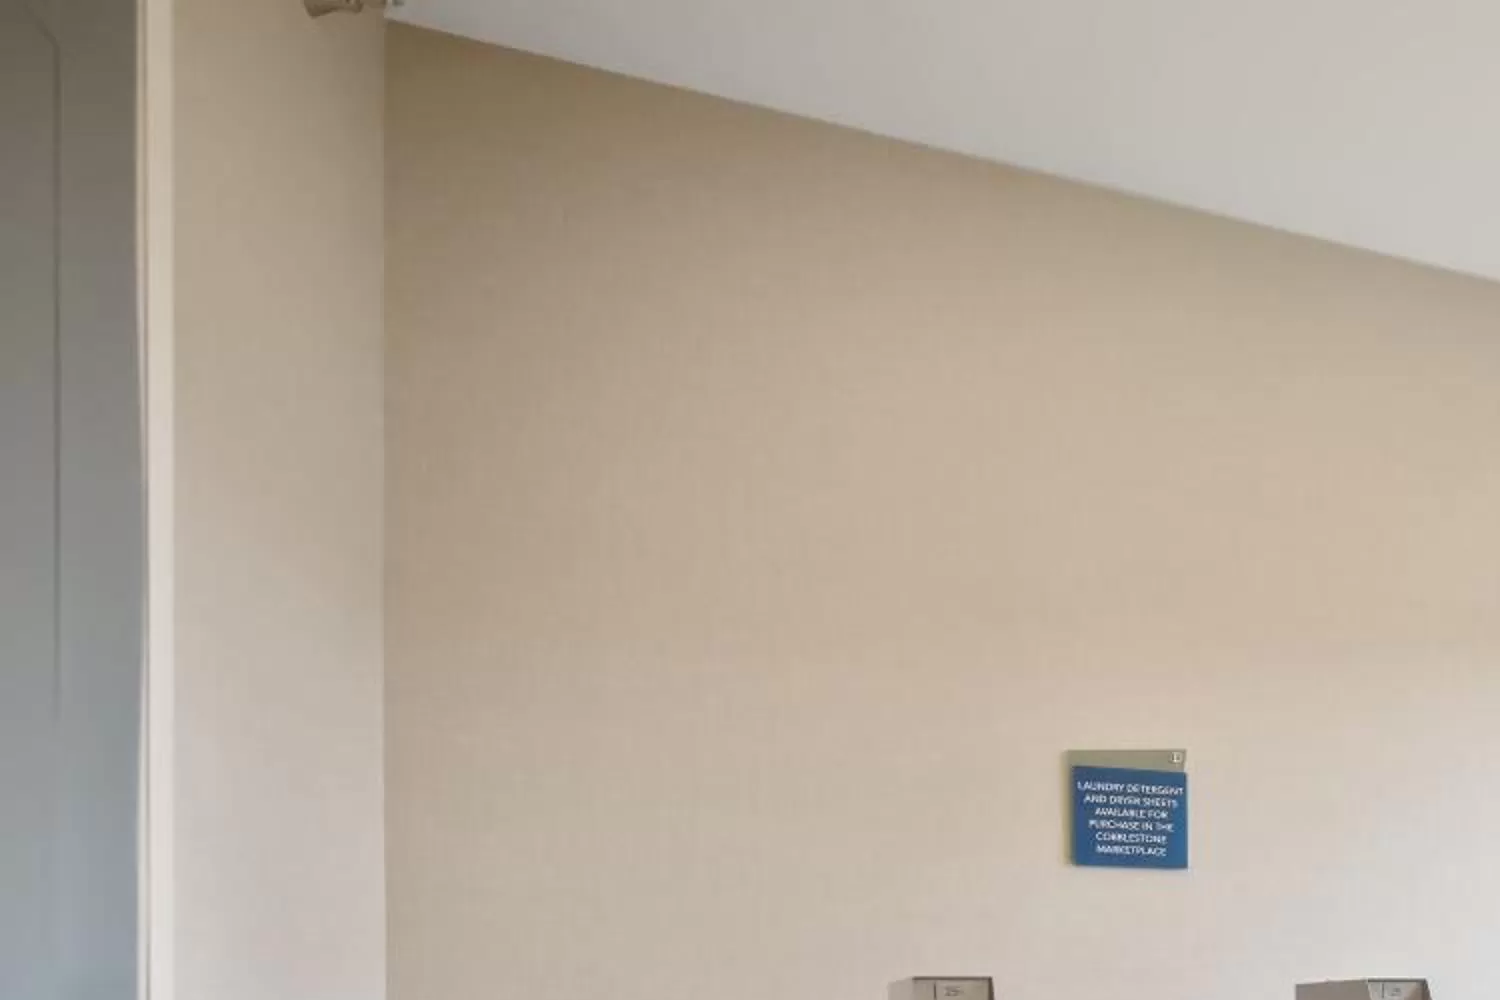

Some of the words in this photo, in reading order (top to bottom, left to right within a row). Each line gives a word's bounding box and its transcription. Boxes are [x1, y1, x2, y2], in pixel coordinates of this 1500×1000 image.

[1077, 781, 1124, 792] LAUNDRY
[1126, 784, 1184, 795] DETERGENT
[1084, 795, 1107, 804] AND
[1109, 796, 1140, 806] DRYER
[1143, 798, 1178, 808] SHEETS
[1095, 807, 1146, 818] AVAILABLE
[1147, 809, 1168, 819] FOR
[1089, 820, 1140, 831] PURCHASE
[1141, 822, 1153, 831] IN
[1155, 823, 1175, 832] THE
[1095, 831, 1167, 844] COBBLESTONE
[1096, 844, 1167, 856] MARKETPLACE
